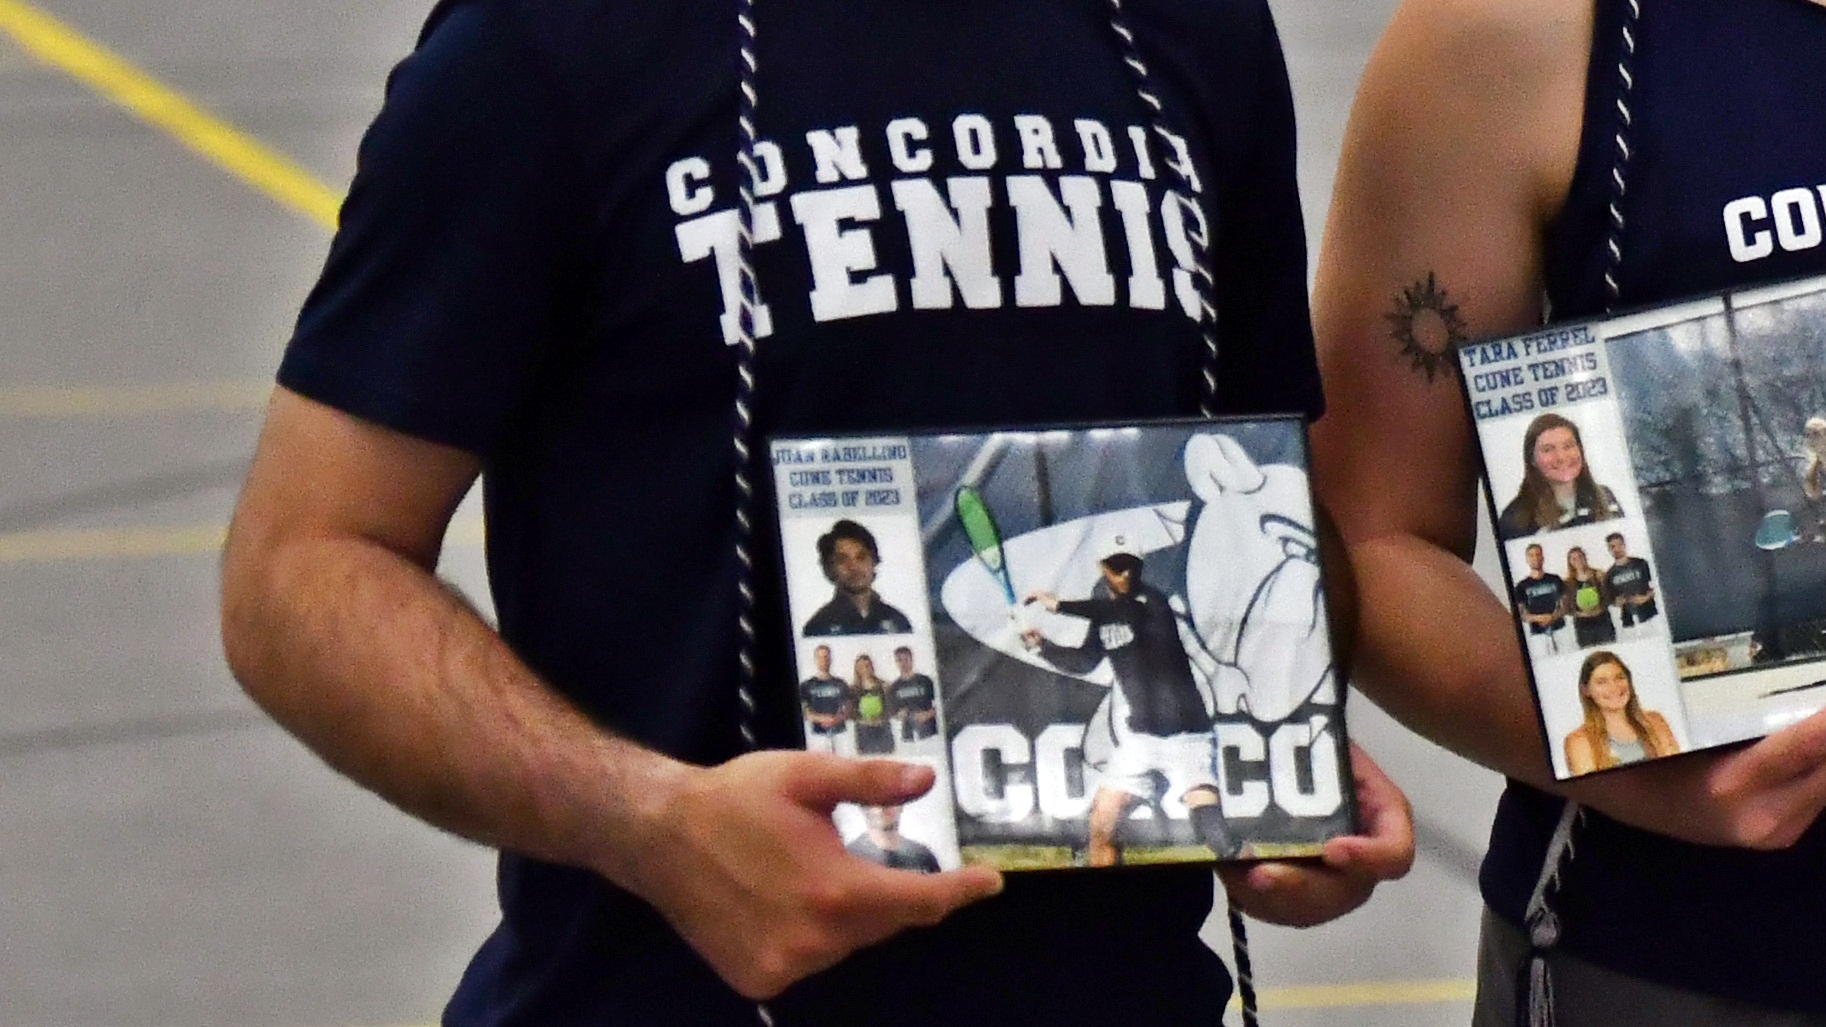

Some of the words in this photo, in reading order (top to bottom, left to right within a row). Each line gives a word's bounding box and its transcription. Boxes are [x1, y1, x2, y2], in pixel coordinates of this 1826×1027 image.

[1463, 343, 1519, 368] TARA
[1474, 366, 1525, 393] CUNE
[1528, 352, 1598, 382] TENNIS
[1474, 391, 1535, 420] CLASS
[1538, 385, 1560, 408] OF
[1564, 377, 1608, 402] 2023
[773, 448, 815, 466] JUAN
[789, 470, 832, 487] CUNE
[835, 467, 894, 485] TENNIS
[789, 490, 837, 509] CLASS
[842, 490, 859, 507] OF
[865, 488, 900, 506] 2023
[951, 723, 1343, 823] COCO
